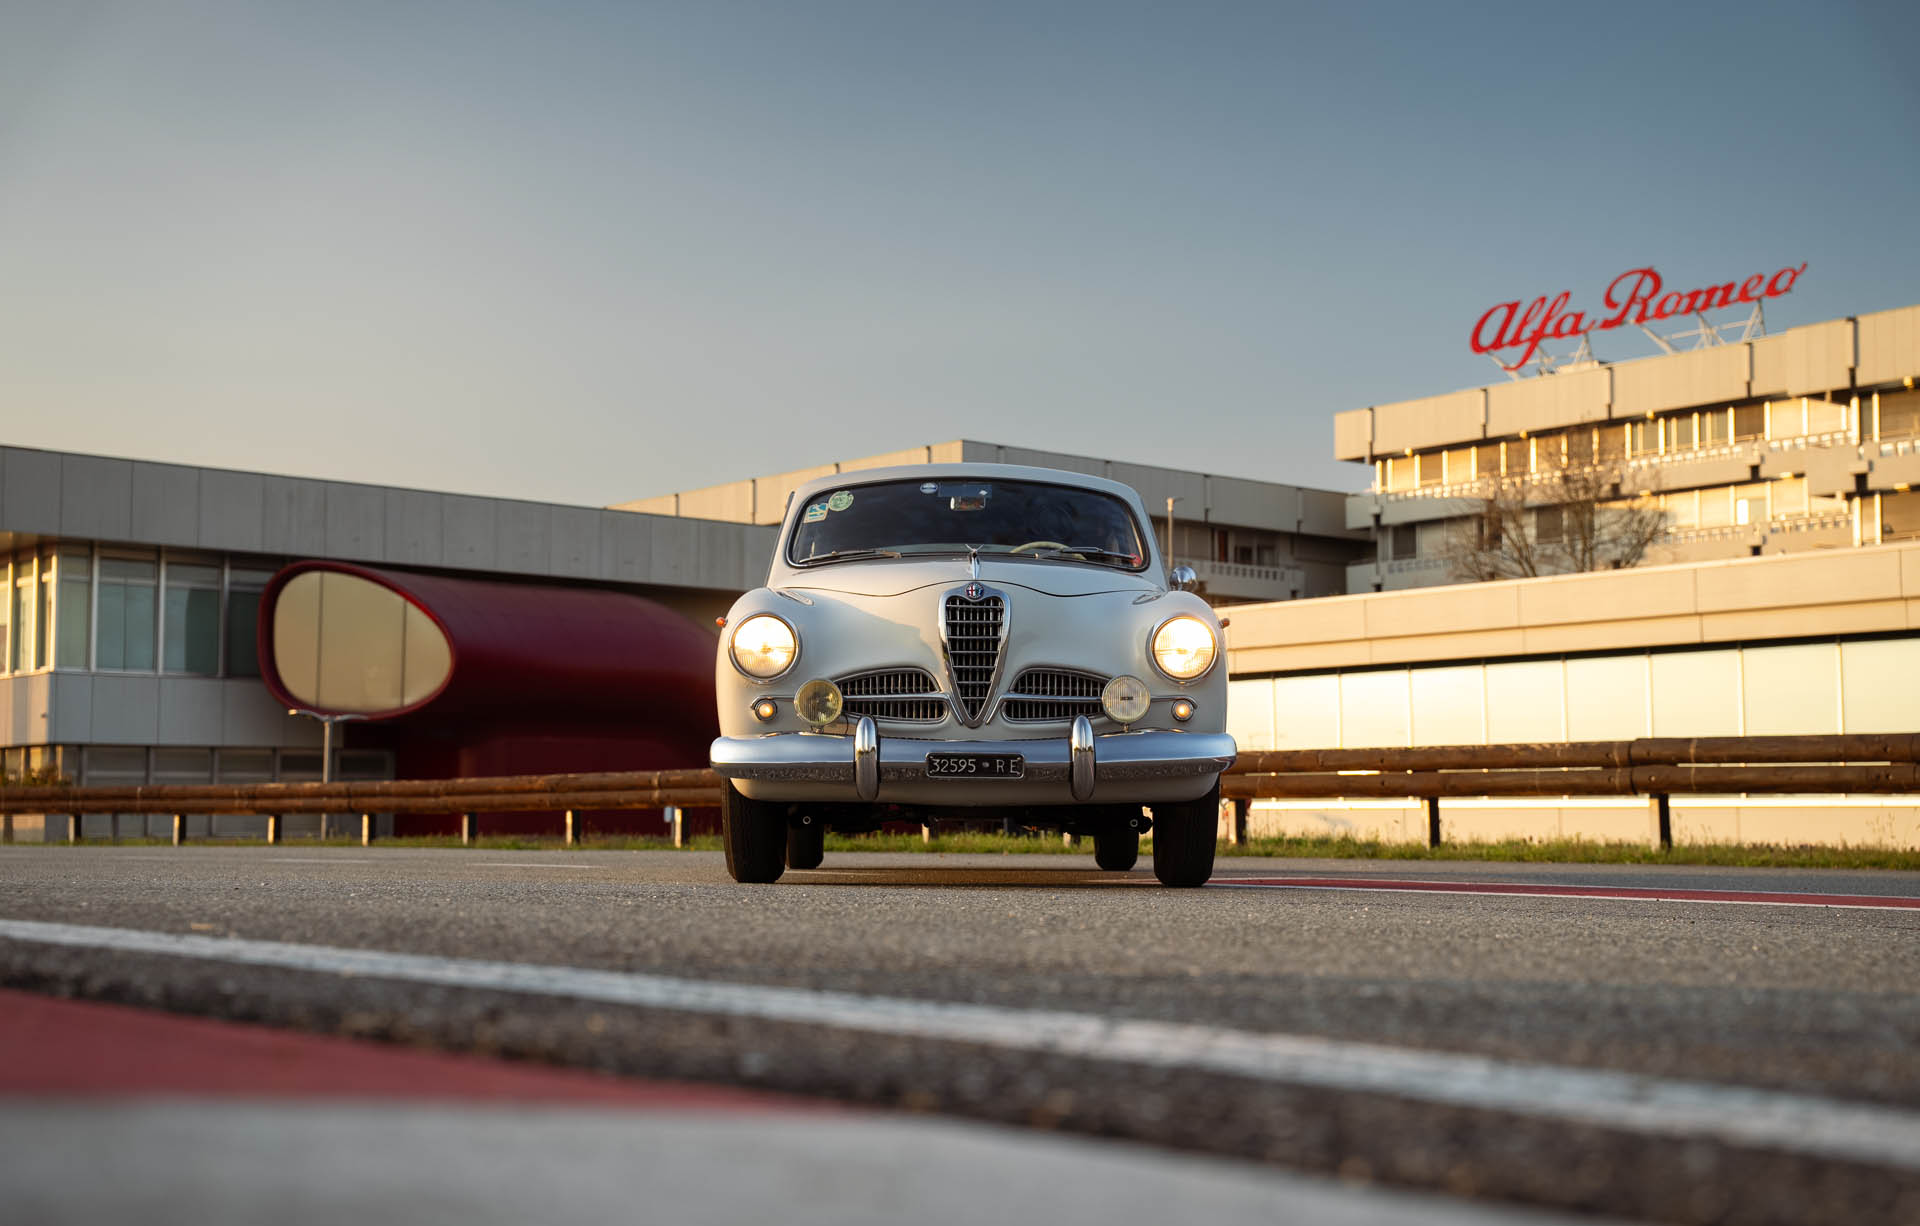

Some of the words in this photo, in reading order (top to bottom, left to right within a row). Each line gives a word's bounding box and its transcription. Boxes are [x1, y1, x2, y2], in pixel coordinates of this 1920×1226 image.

[1470, 291, 1597, 371] Alfa
[1599, 261, 1808, 331] Romeo
[931, 758, 977, 773] 32595
